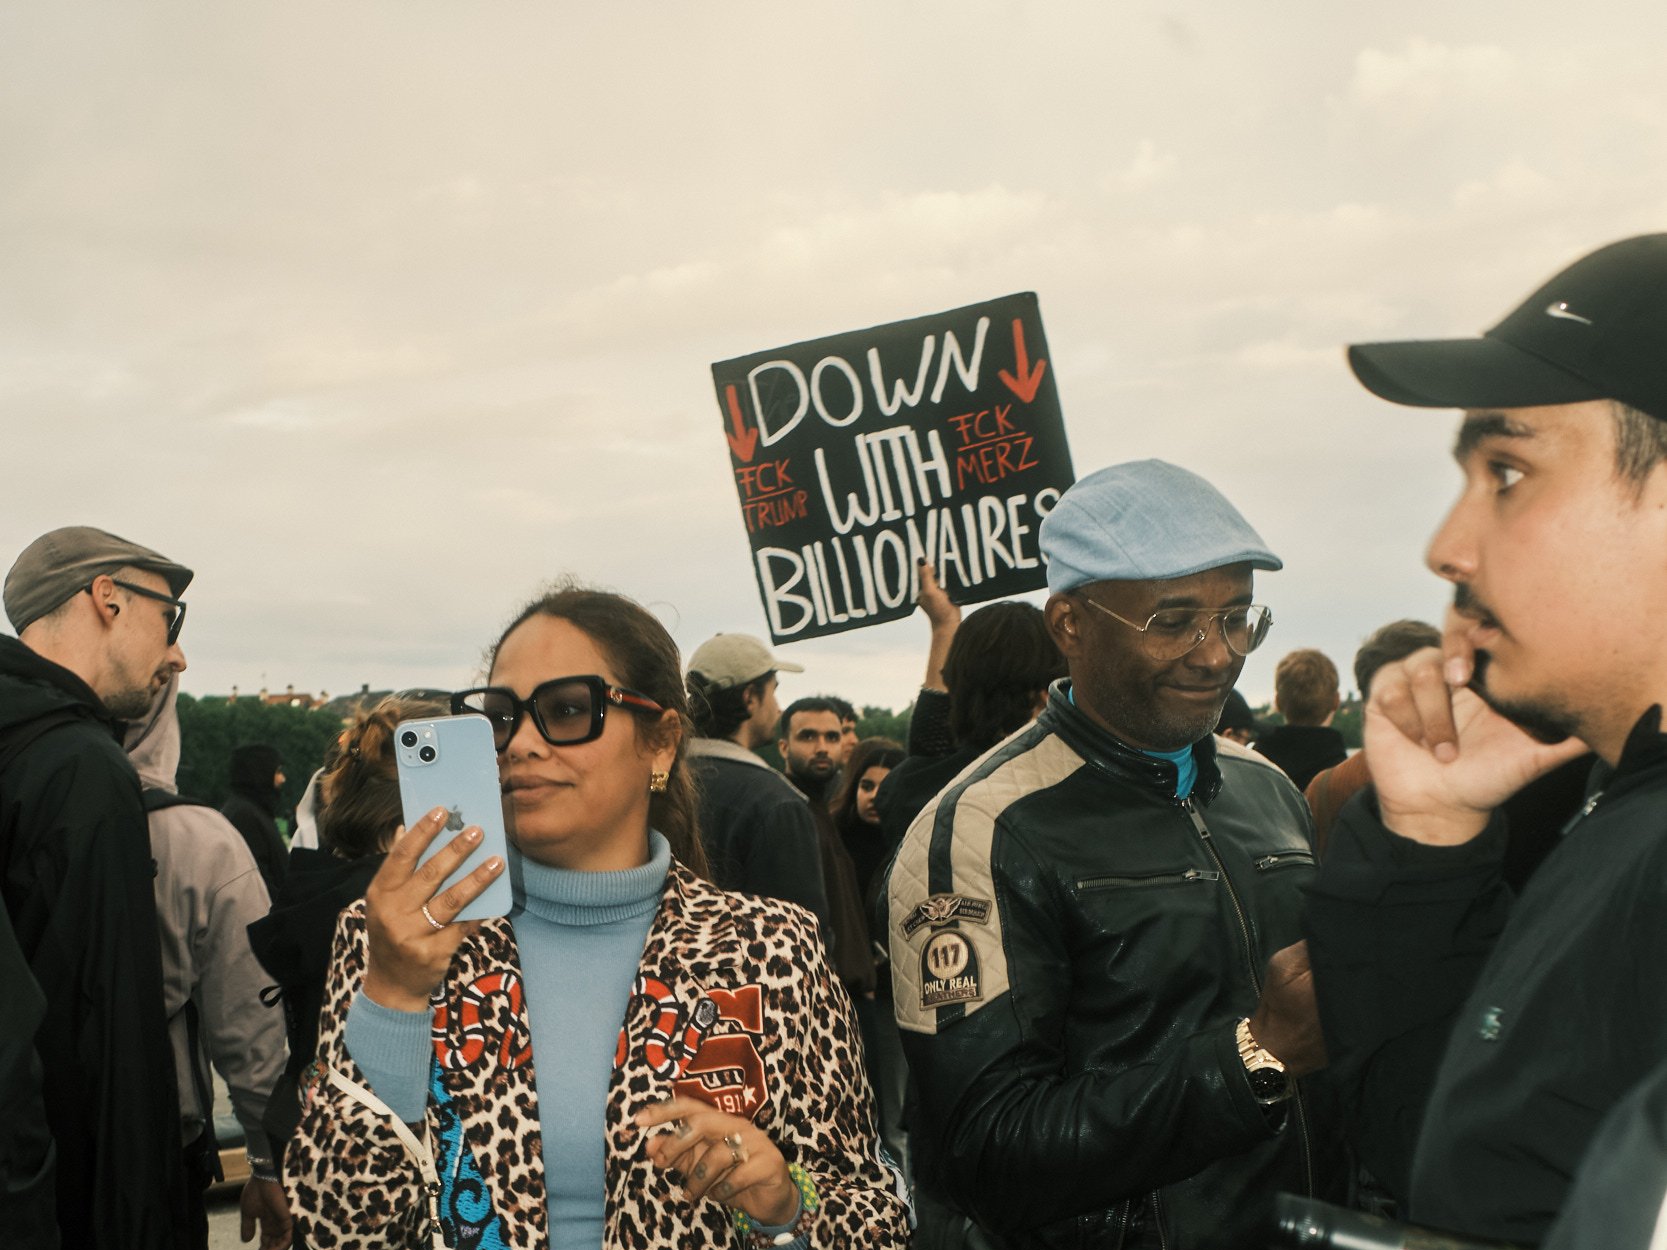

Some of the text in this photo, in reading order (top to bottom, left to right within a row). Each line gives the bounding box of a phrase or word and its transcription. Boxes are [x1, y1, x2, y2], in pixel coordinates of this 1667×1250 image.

[748, 317, 990, 447] DOWN
[948, 404, 1016, 445] FCK
[735, 458, 795, 498] FCK
[814, 425, 953, 534] WITH
[956, 437, 1040, 491] MERZ
[743, 490, 808, 534] TRUMP
[925, 975, 977, 994] ONLY REAL
